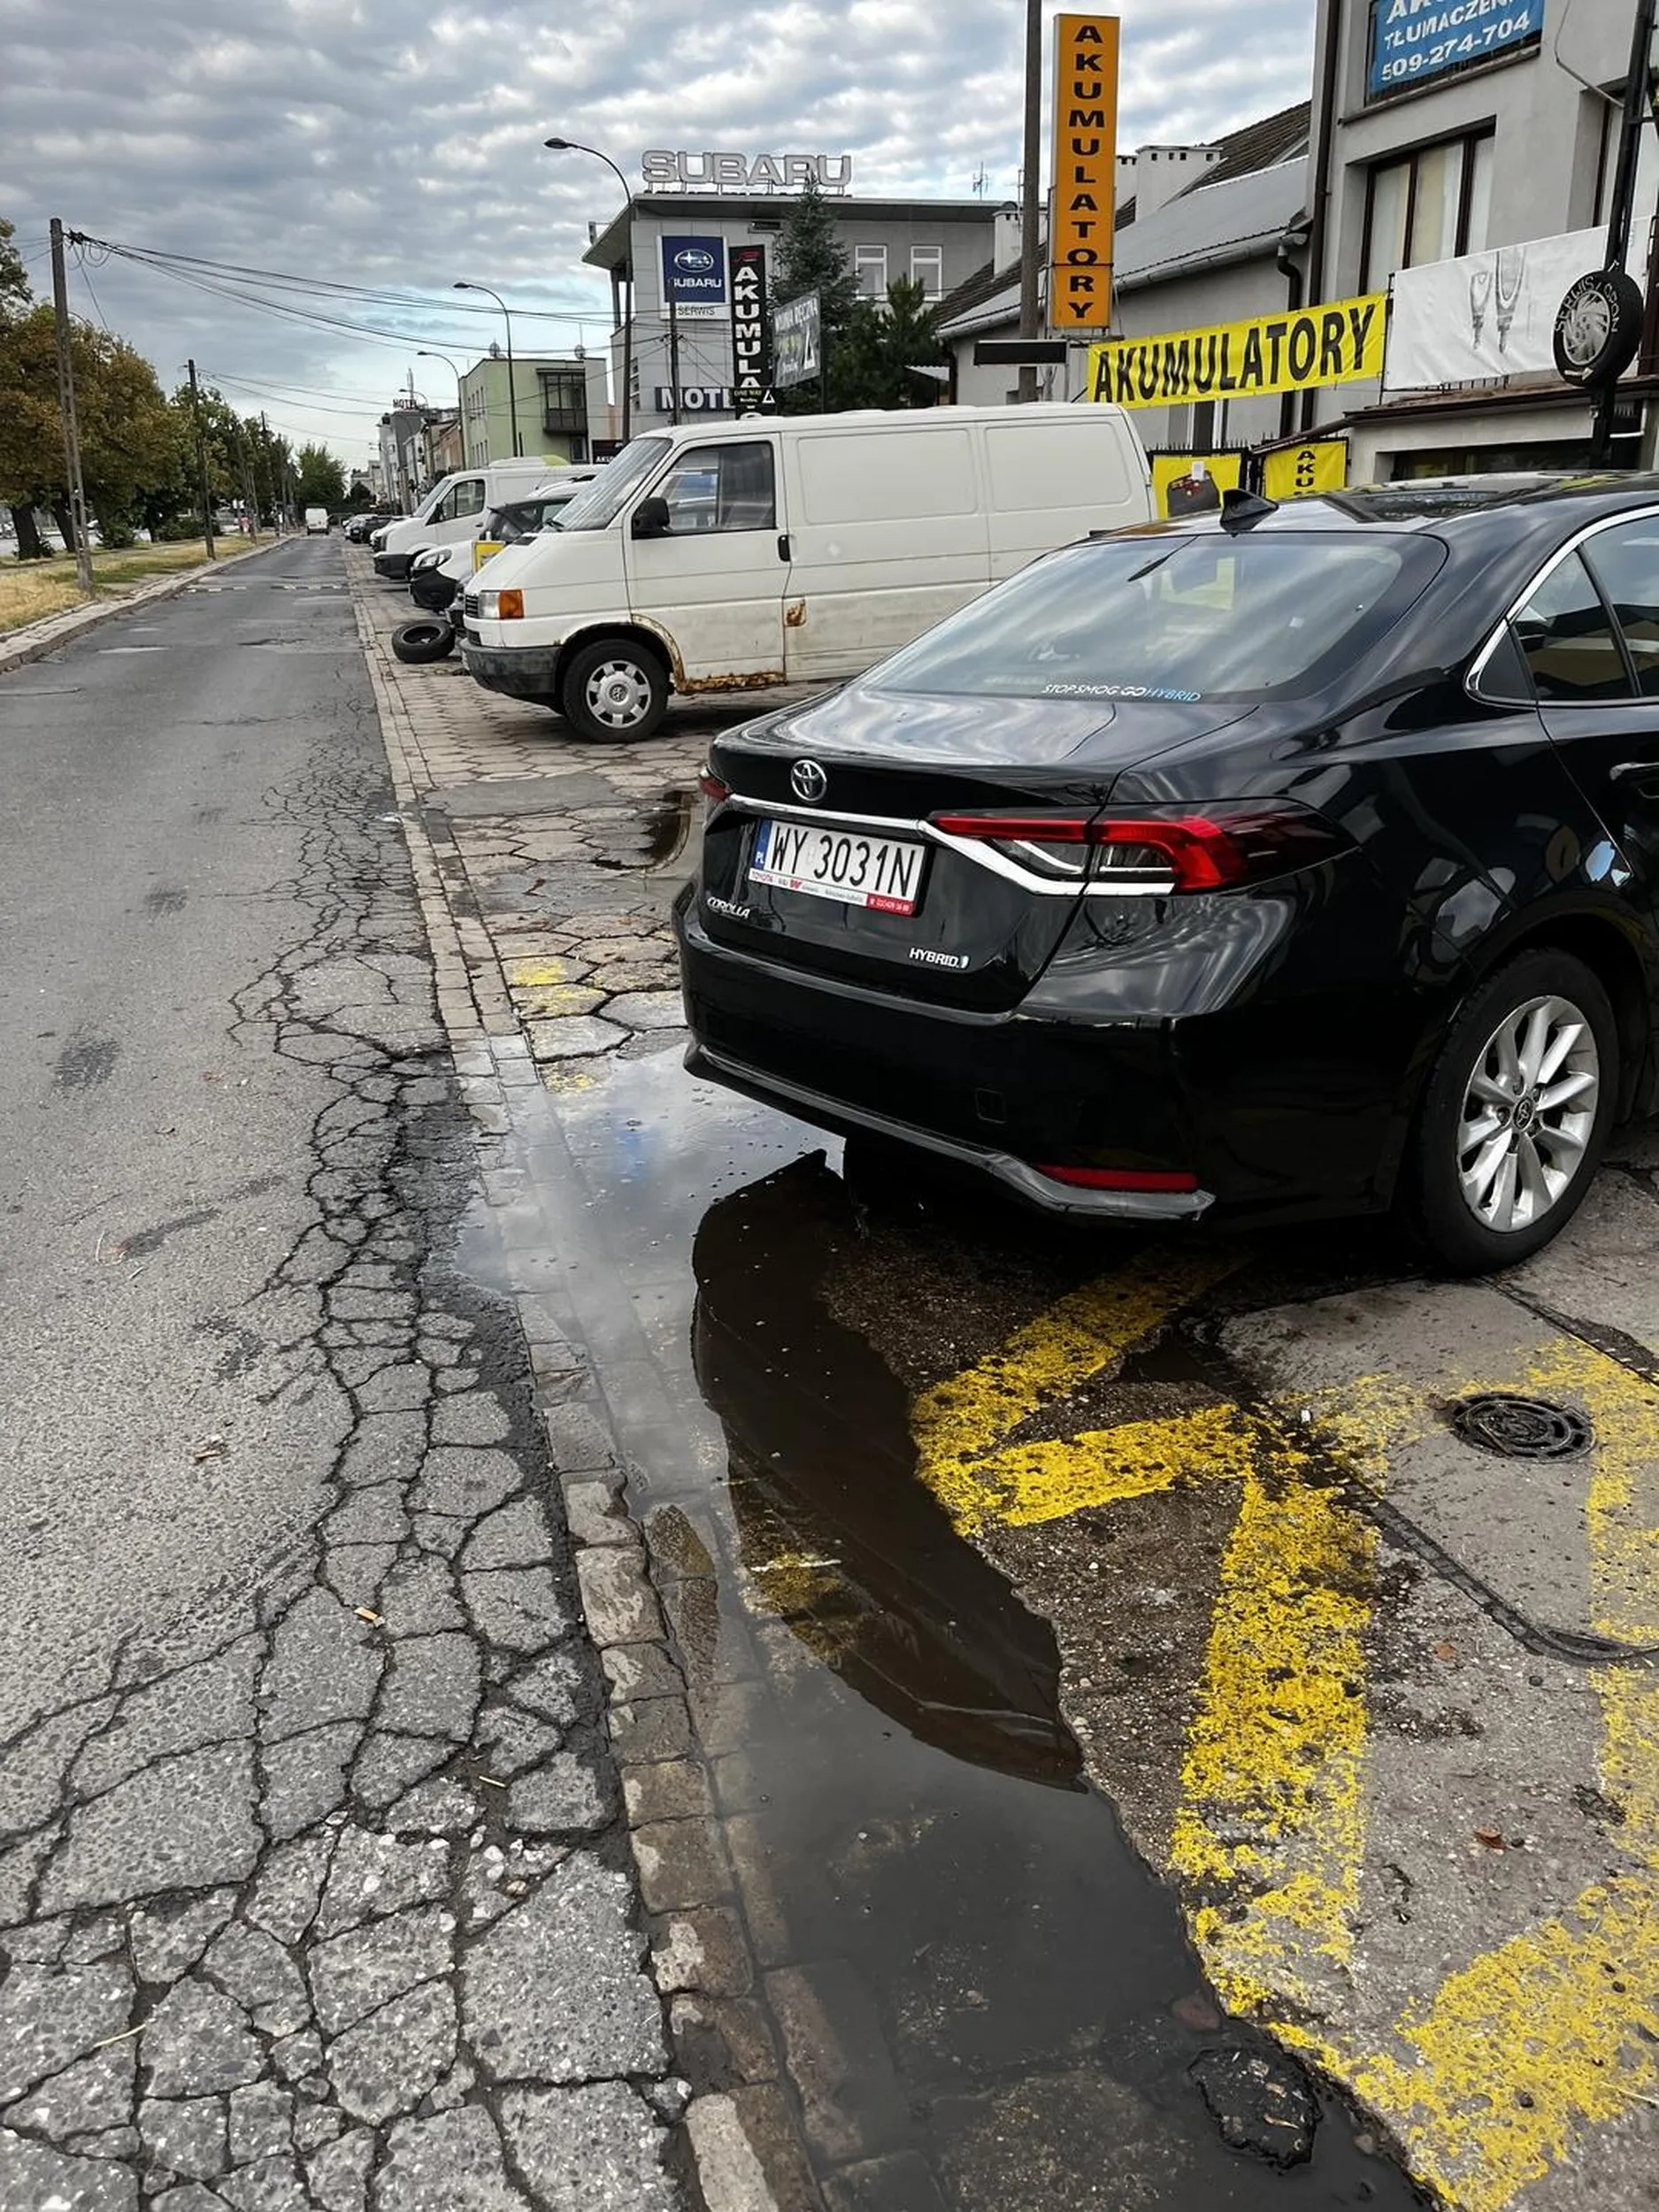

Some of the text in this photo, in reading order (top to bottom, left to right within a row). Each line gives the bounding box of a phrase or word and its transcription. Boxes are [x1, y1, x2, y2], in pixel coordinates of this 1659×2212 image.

[1381, 10, 1531, 81] 509-274-704
[641, 150, 852, 187] SUBARU
[1068, 25, 1105, 319] AKUMULATORY
[668, 277, 722, 288] UBARU
[677, 305, 716, 316] SERWIS
[1094, 303, 1376, 403] AKUMULATORY
[772, 826, 916, 897] WY 3031N
[707, 896, 750, 919] COROLLA
